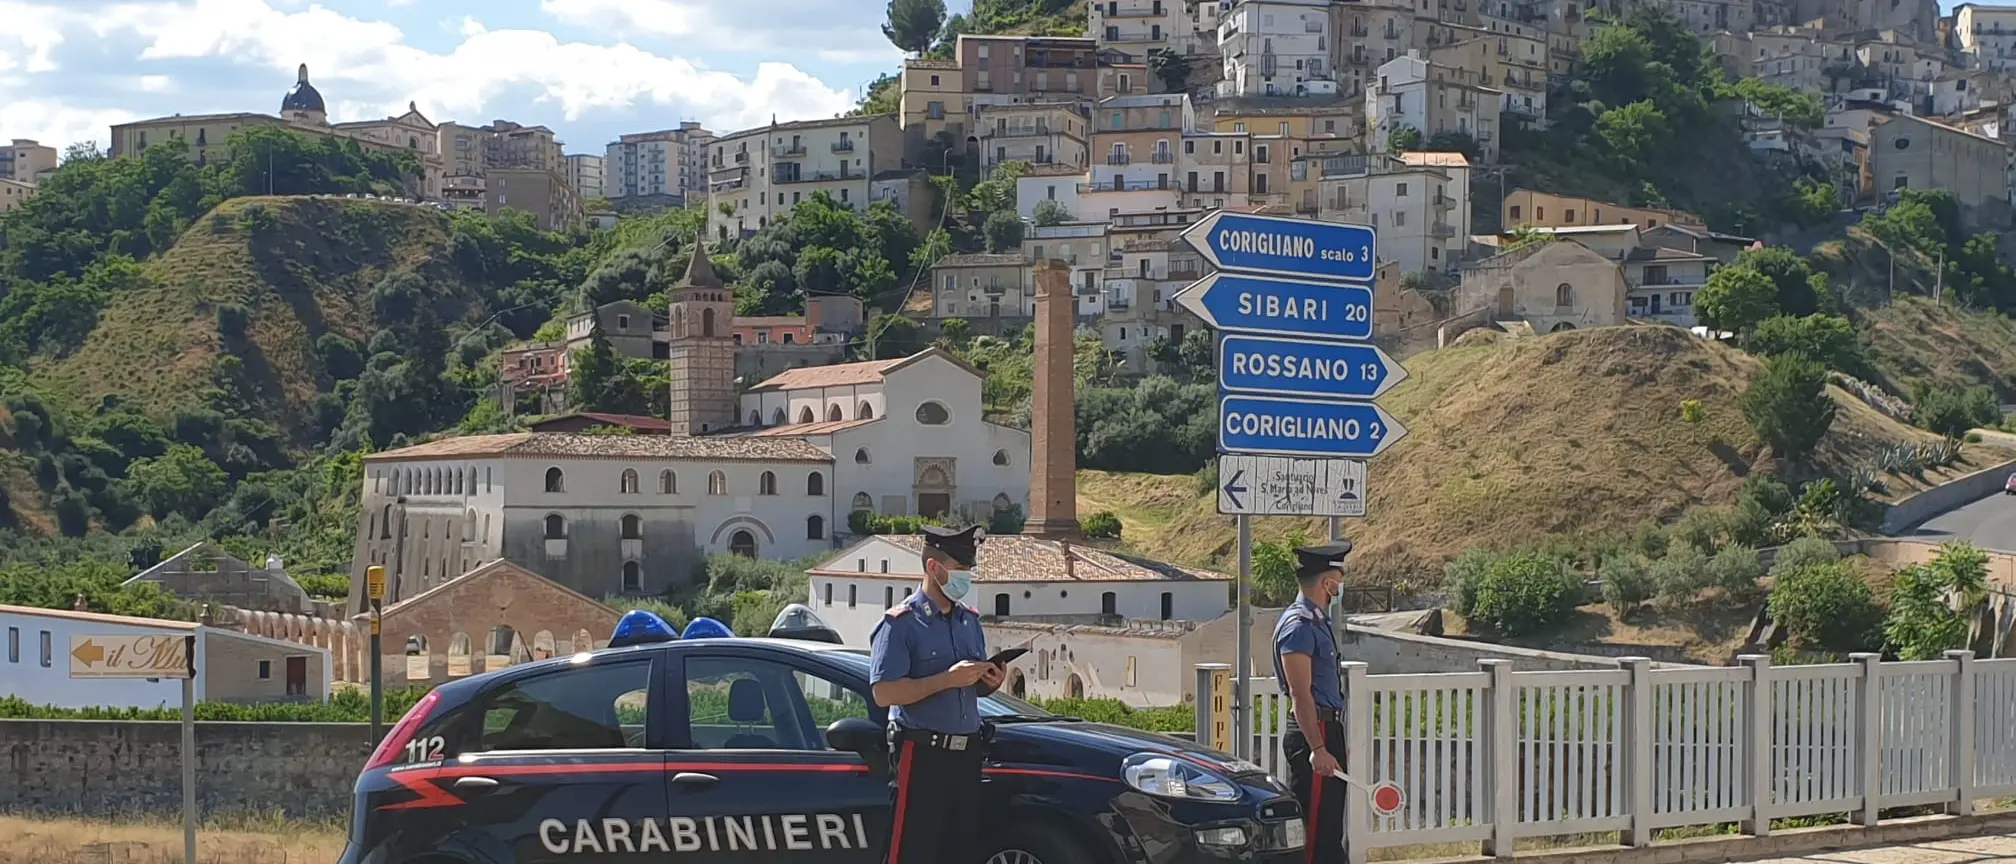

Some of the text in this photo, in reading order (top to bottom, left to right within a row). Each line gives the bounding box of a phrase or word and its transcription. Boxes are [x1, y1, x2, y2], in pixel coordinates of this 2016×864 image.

[1219, 229, 1369, 263] CORIGLIANO scalo 3
[1238, 292, 1367, 322] SIBARI 20
[1233, 352, 1378, 381] ROSSANO 13
[1226, 412, 1380, 440] CORIGLIANO 2
[1270, 484, 1292, 495] Mara
[106, 644, 126, 668] il
[405, 736, 445, 764] 112
[539, 813, 869, 854] CARABINIERI
